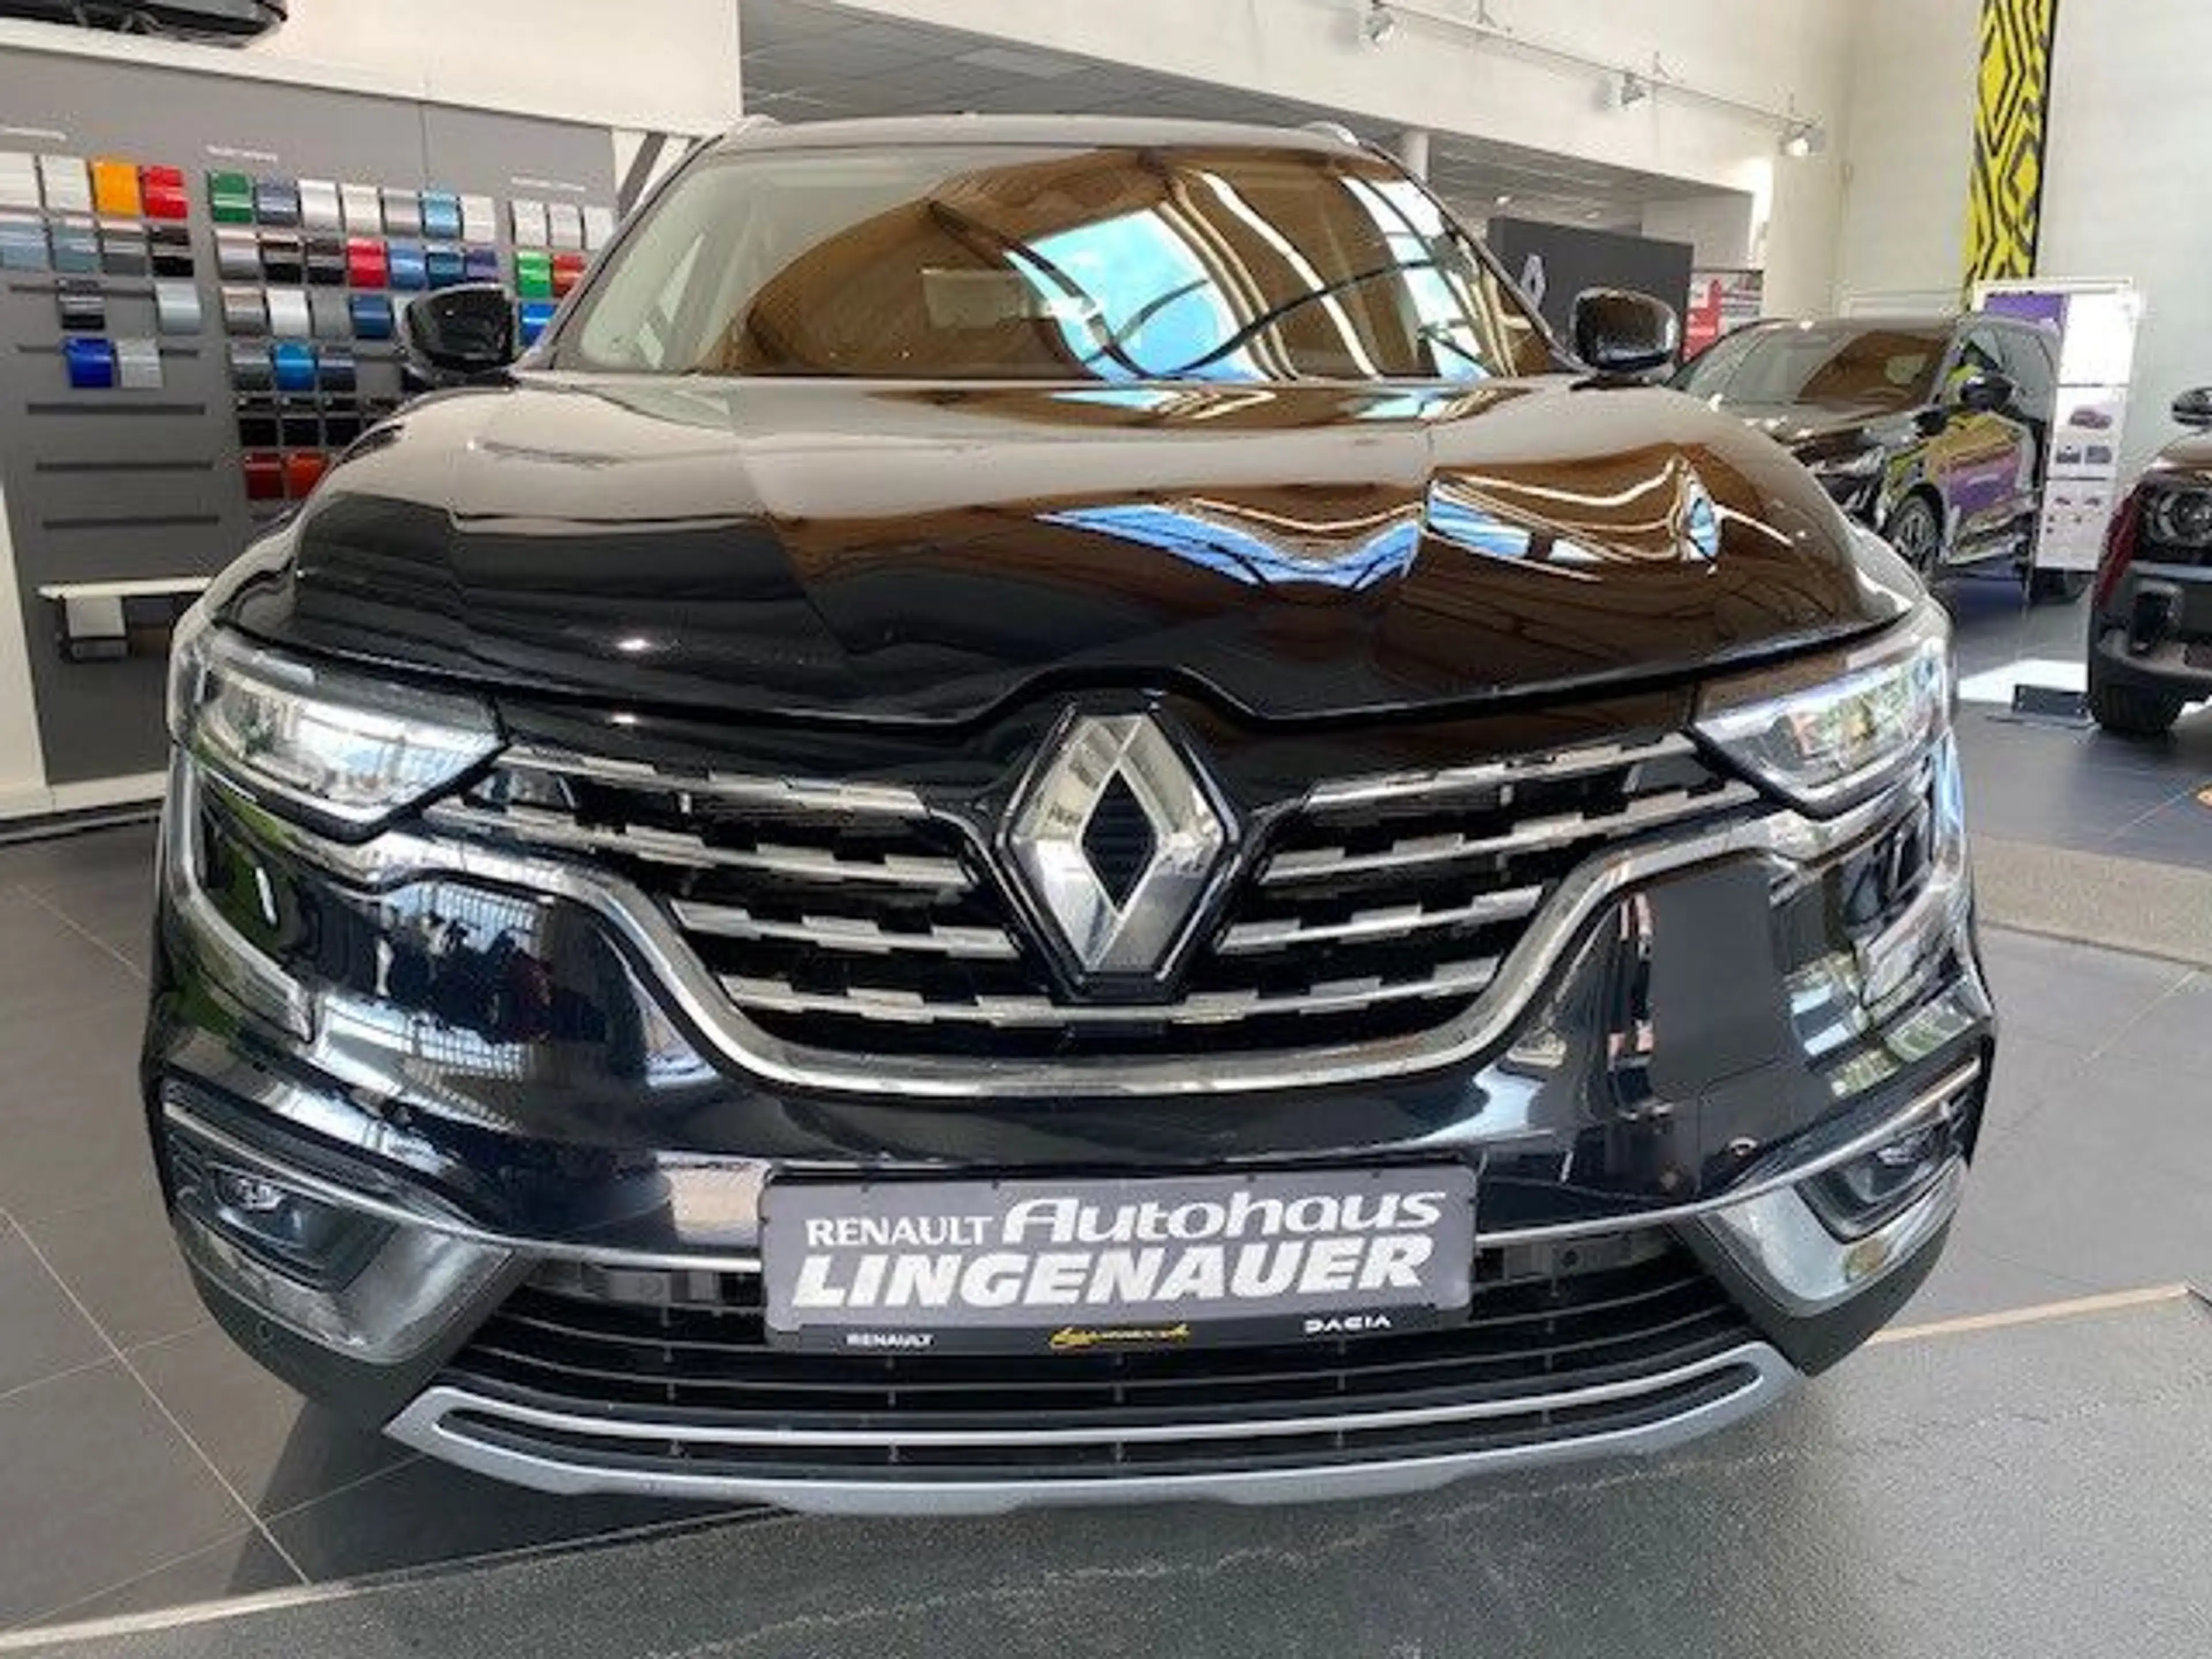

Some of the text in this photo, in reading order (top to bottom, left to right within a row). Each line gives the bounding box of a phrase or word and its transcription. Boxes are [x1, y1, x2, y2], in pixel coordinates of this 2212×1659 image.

[806, 1191, 1446, 1245] RENAULT Autohaus
[791, 1233, 1433, 1307] LINGENAUER
[846, 1332, 934, 1347] RENAULT
[1304, 1313, 1392, 1334] DACIA
